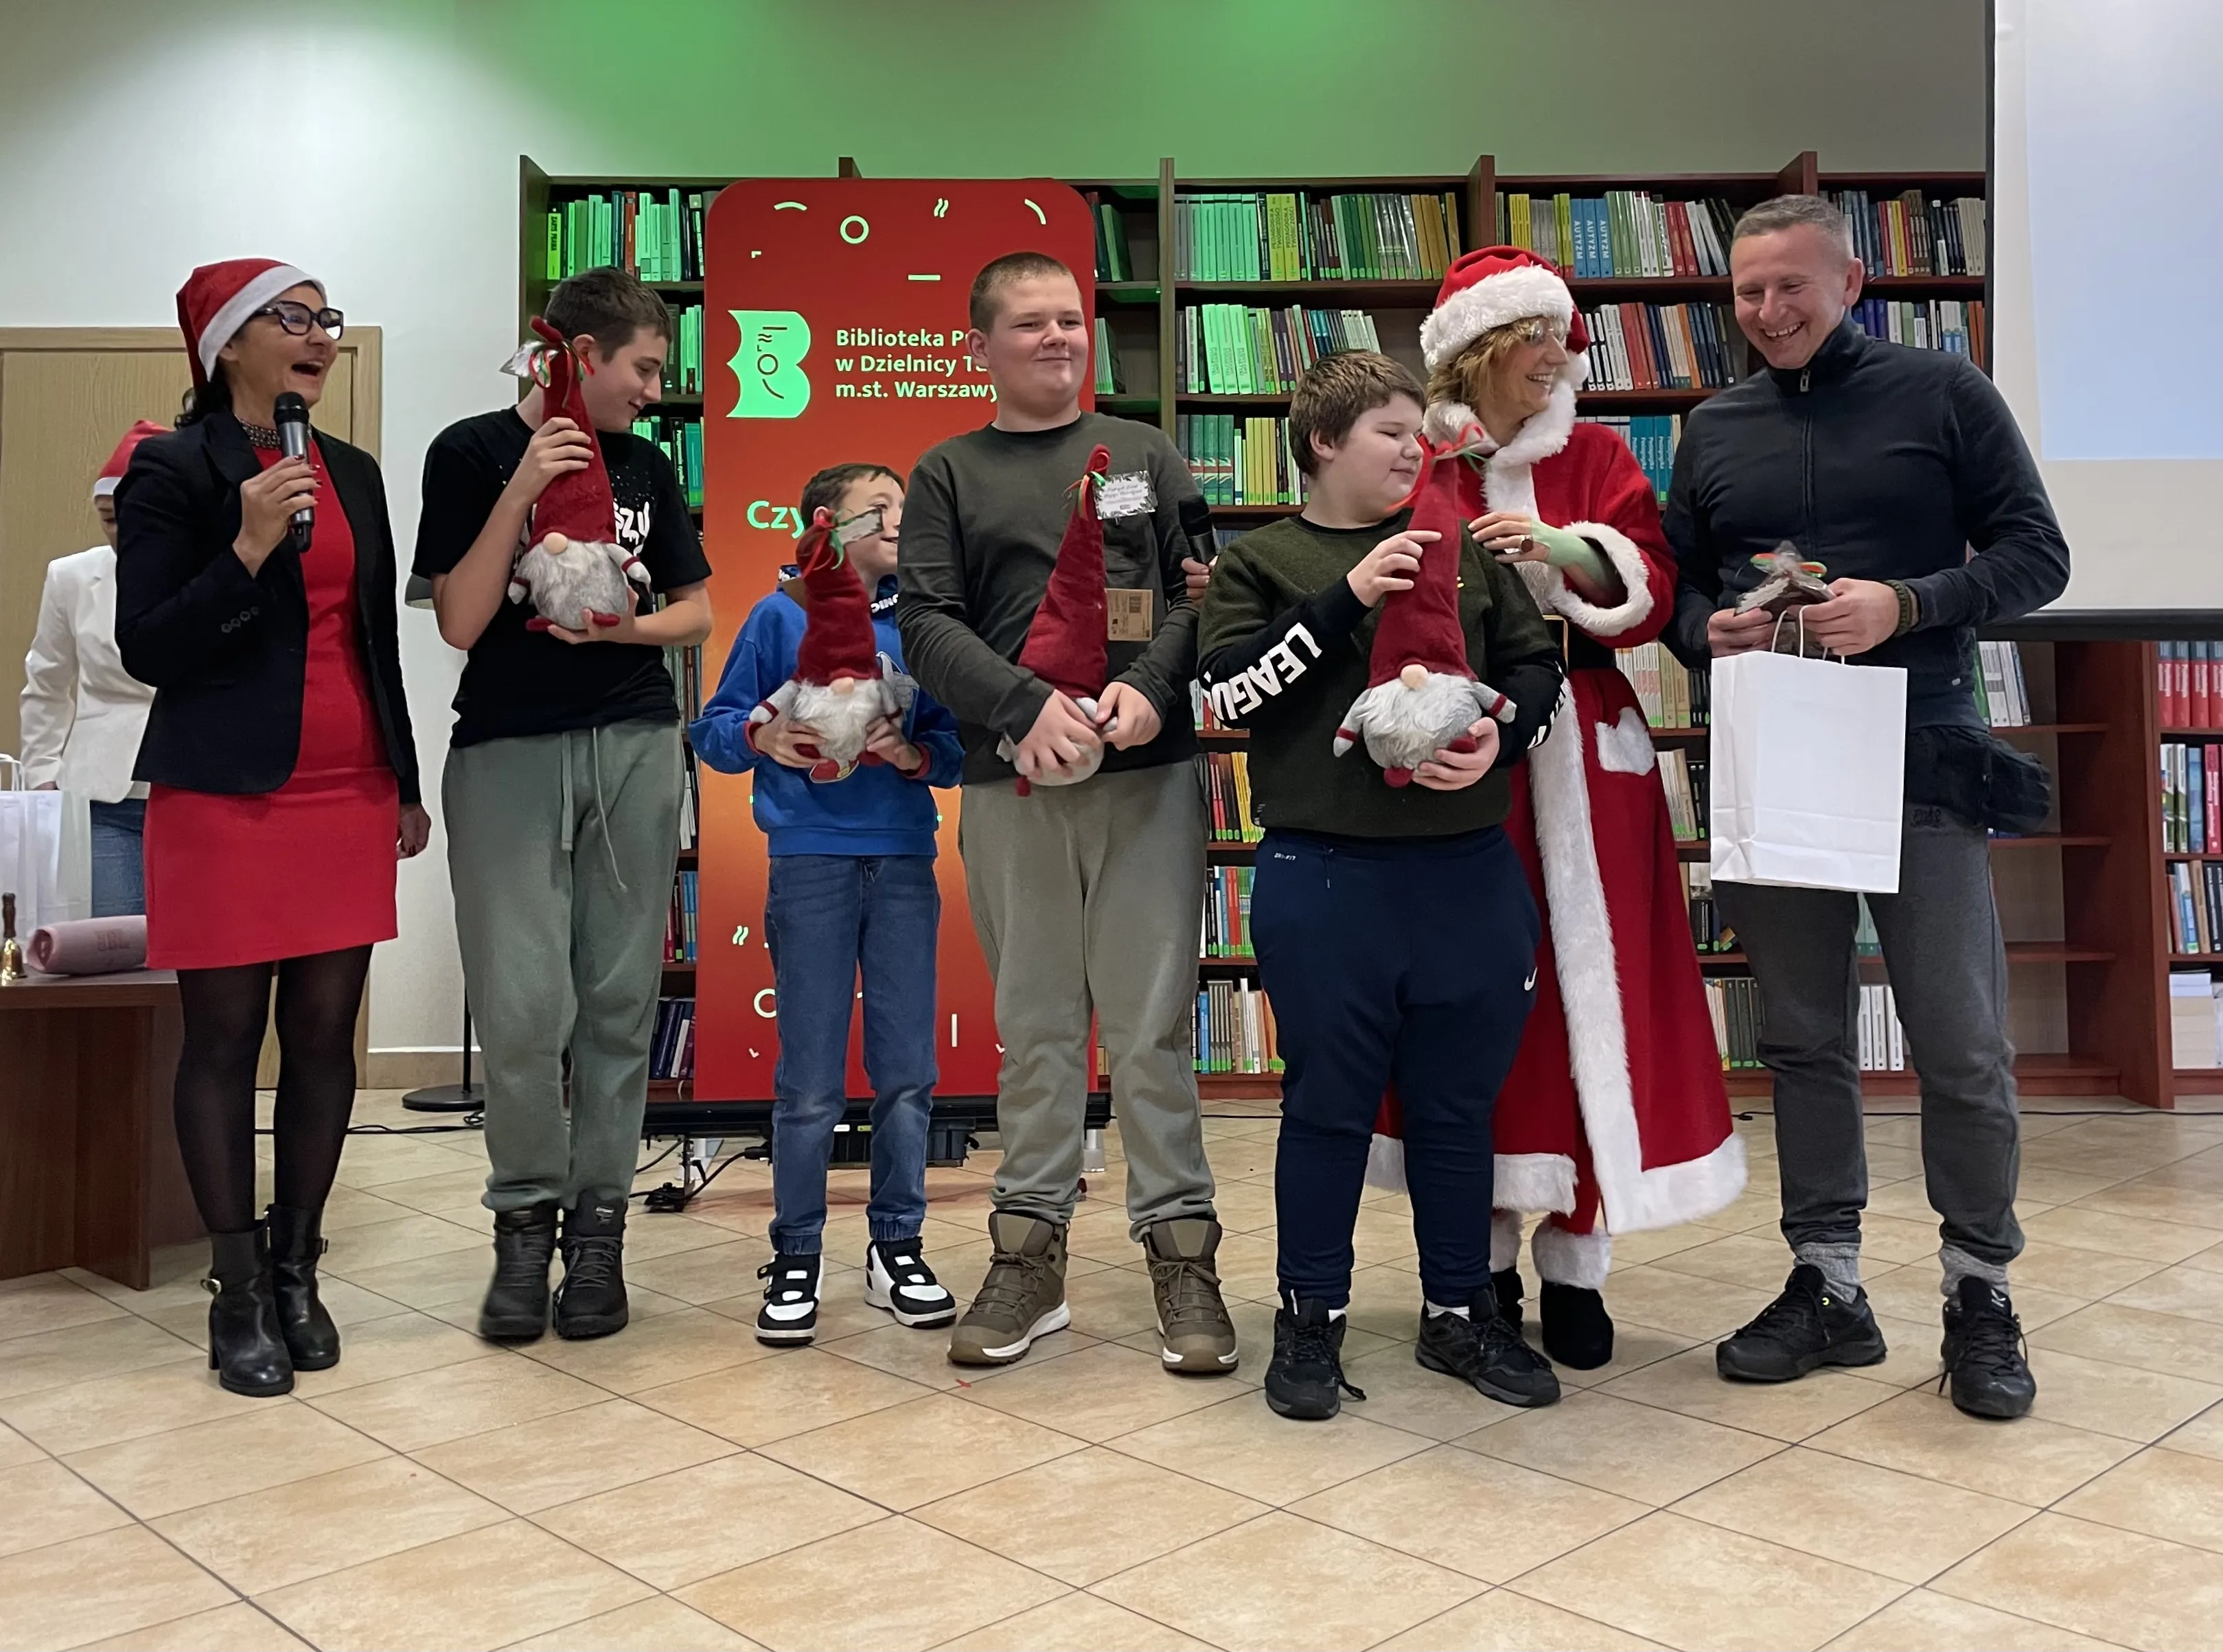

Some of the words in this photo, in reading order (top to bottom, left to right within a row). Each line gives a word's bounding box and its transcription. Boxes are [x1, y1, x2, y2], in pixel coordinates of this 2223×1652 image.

[1574, 220, 1583, 259] AUTYZM
[1587, 220, 1596, 259] AUTYZM
[1600, 219, 1609, 259] AUTYZM
[836, 328, 944, 347] Biblioteka
[952, 330, 968, 347] P
[835, 358, 854, 371] w
[860, 353, 957, 377] Dzielnicy
[836, 381, 888, 397] m.st.
[894, 381, 998, 403] Warszawy
[1203, 622, 1322, 720] LEAGU
